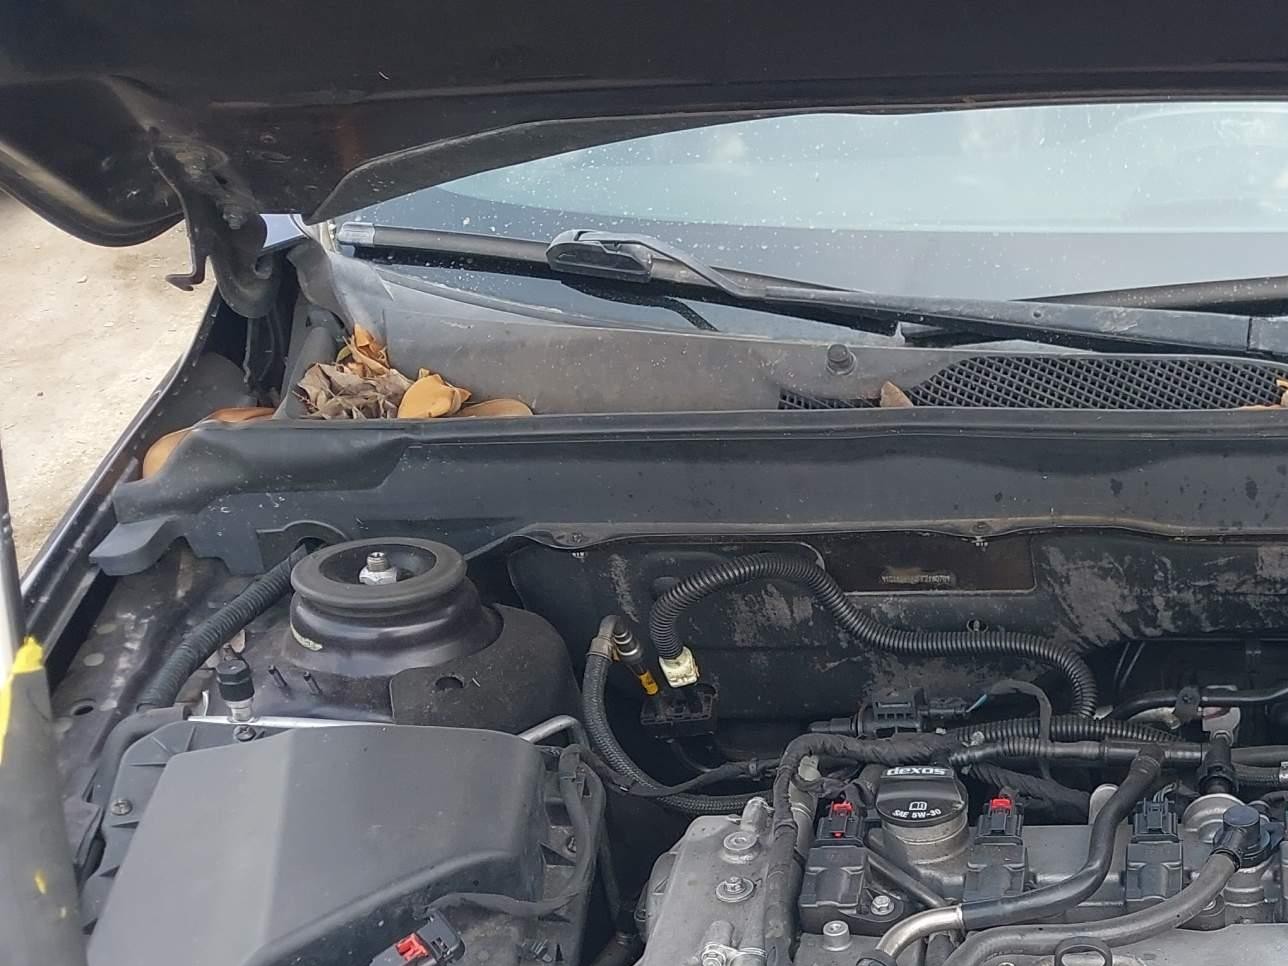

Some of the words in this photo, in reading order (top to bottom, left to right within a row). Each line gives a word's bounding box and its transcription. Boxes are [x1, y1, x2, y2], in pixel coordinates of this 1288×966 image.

[886, 766, 946, 776] dexos
[892, 809, 910, 818] SAE
[911, 808, 942, 819] 5W-30
